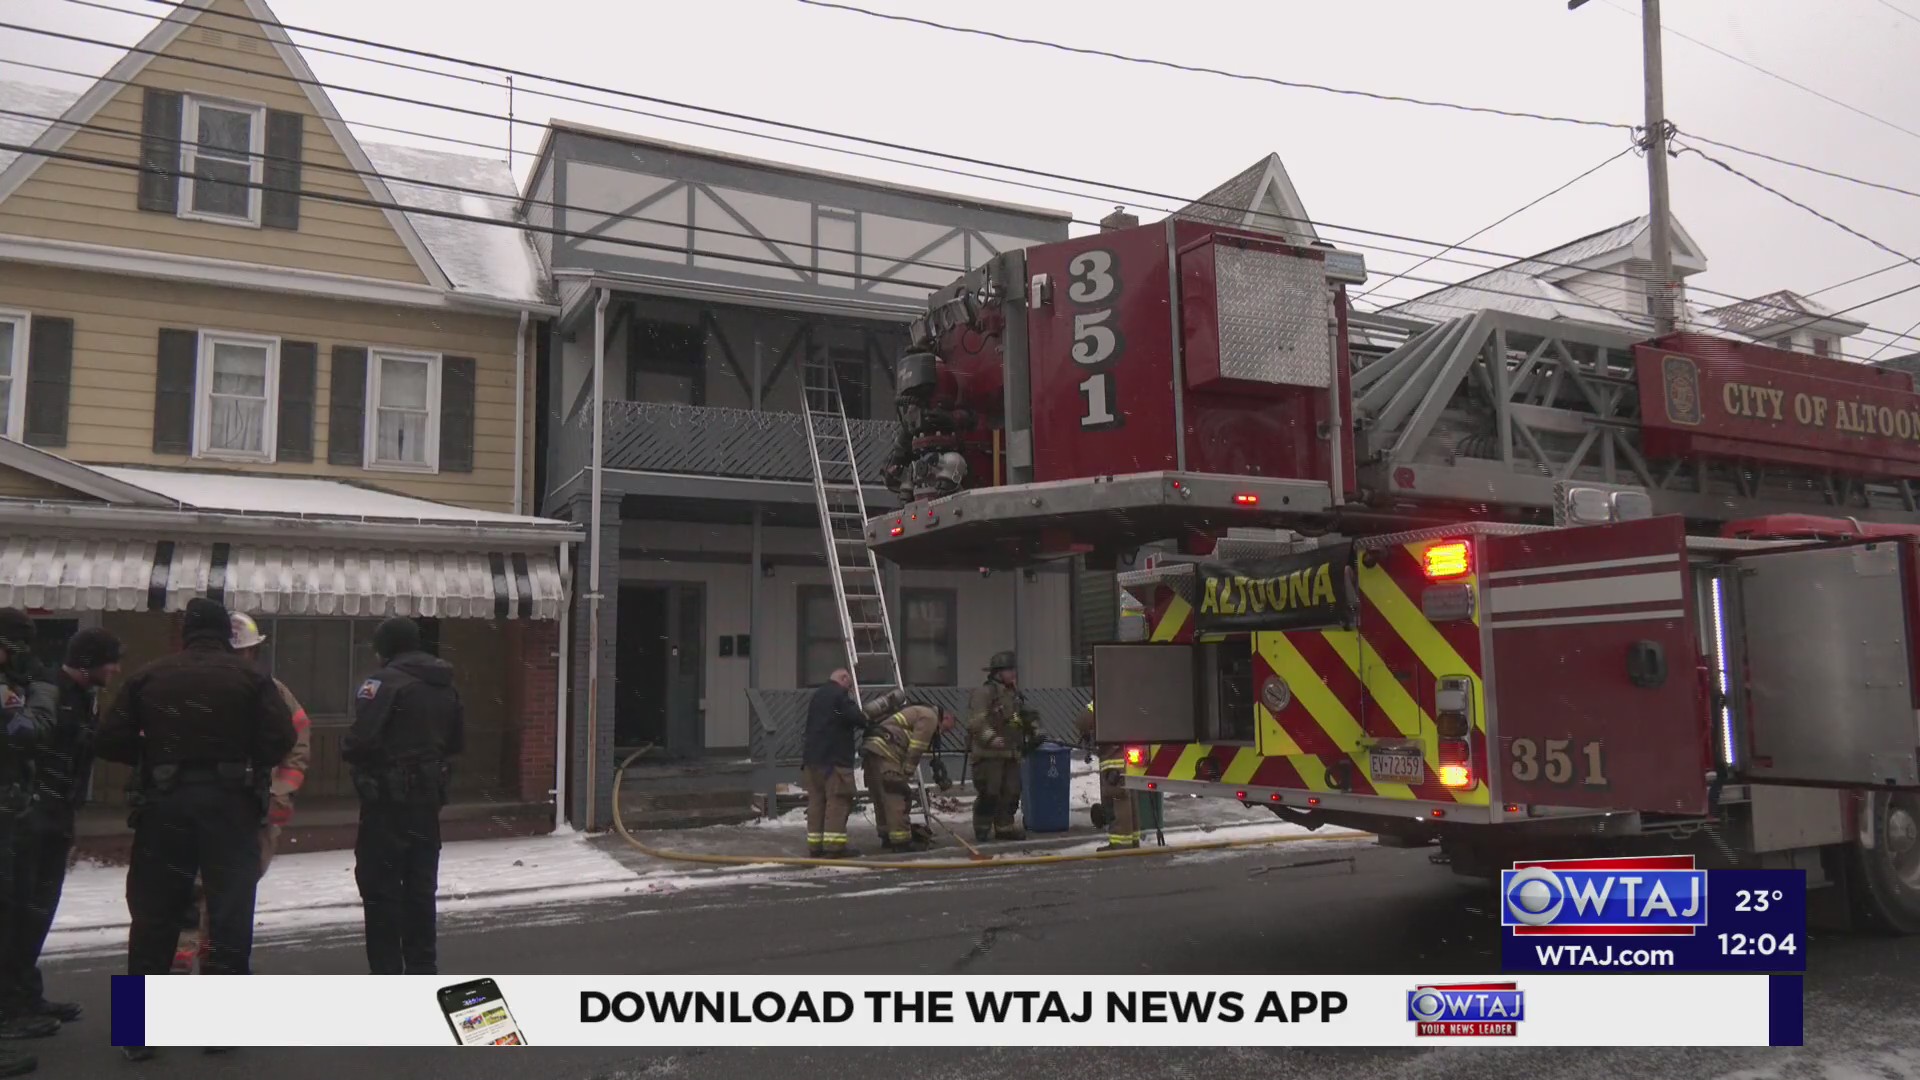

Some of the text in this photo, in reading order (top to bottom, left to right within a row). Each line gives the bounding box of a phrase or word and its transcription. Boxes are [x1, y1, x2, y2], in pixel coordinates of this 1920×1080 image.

[1069, 250, 1116, 426] 351
[1723, 382, 1784, 420] CITY
[1794, 393, 1828, 426] OF
[1201, 562, 1336, 614] ALTOONA
[1511, 738, 1607, 785] 351
